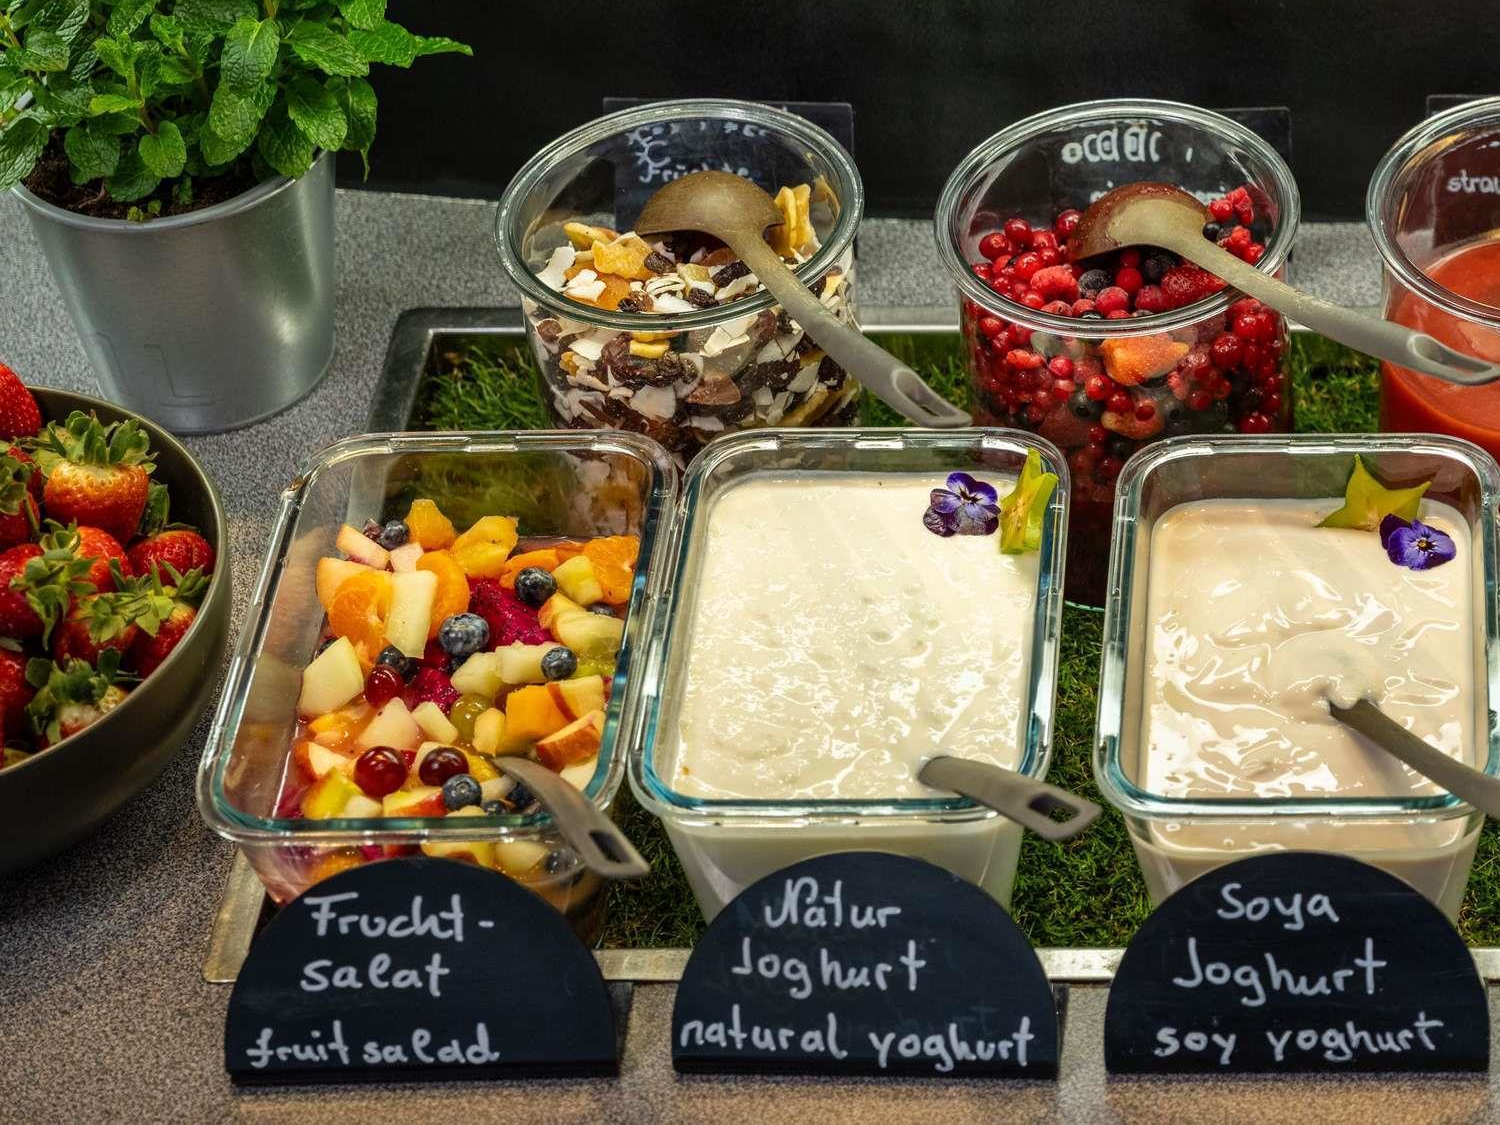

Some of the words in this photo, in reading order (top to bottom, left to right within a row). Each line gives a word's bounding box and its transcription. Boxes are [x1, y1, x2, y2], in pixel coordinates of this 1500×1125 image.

[765, 877, 902, 928] Natur
[1217, 883, 1339, 930] Soya
[732, 937, 926, 999] Joghurt
[1173, 937, 1387, 1006] Joghurt
[246, 1020, 349, 1067] fruit
[363, 1023, 500, 1064] salad
[681, 1004, 848, 1057] natural
[869, 1016, 1035, 1071] yoghurt
[1154, 1027, 1236, 1064] soy
[1267, 1012, 1444, 1061] yoghurt
